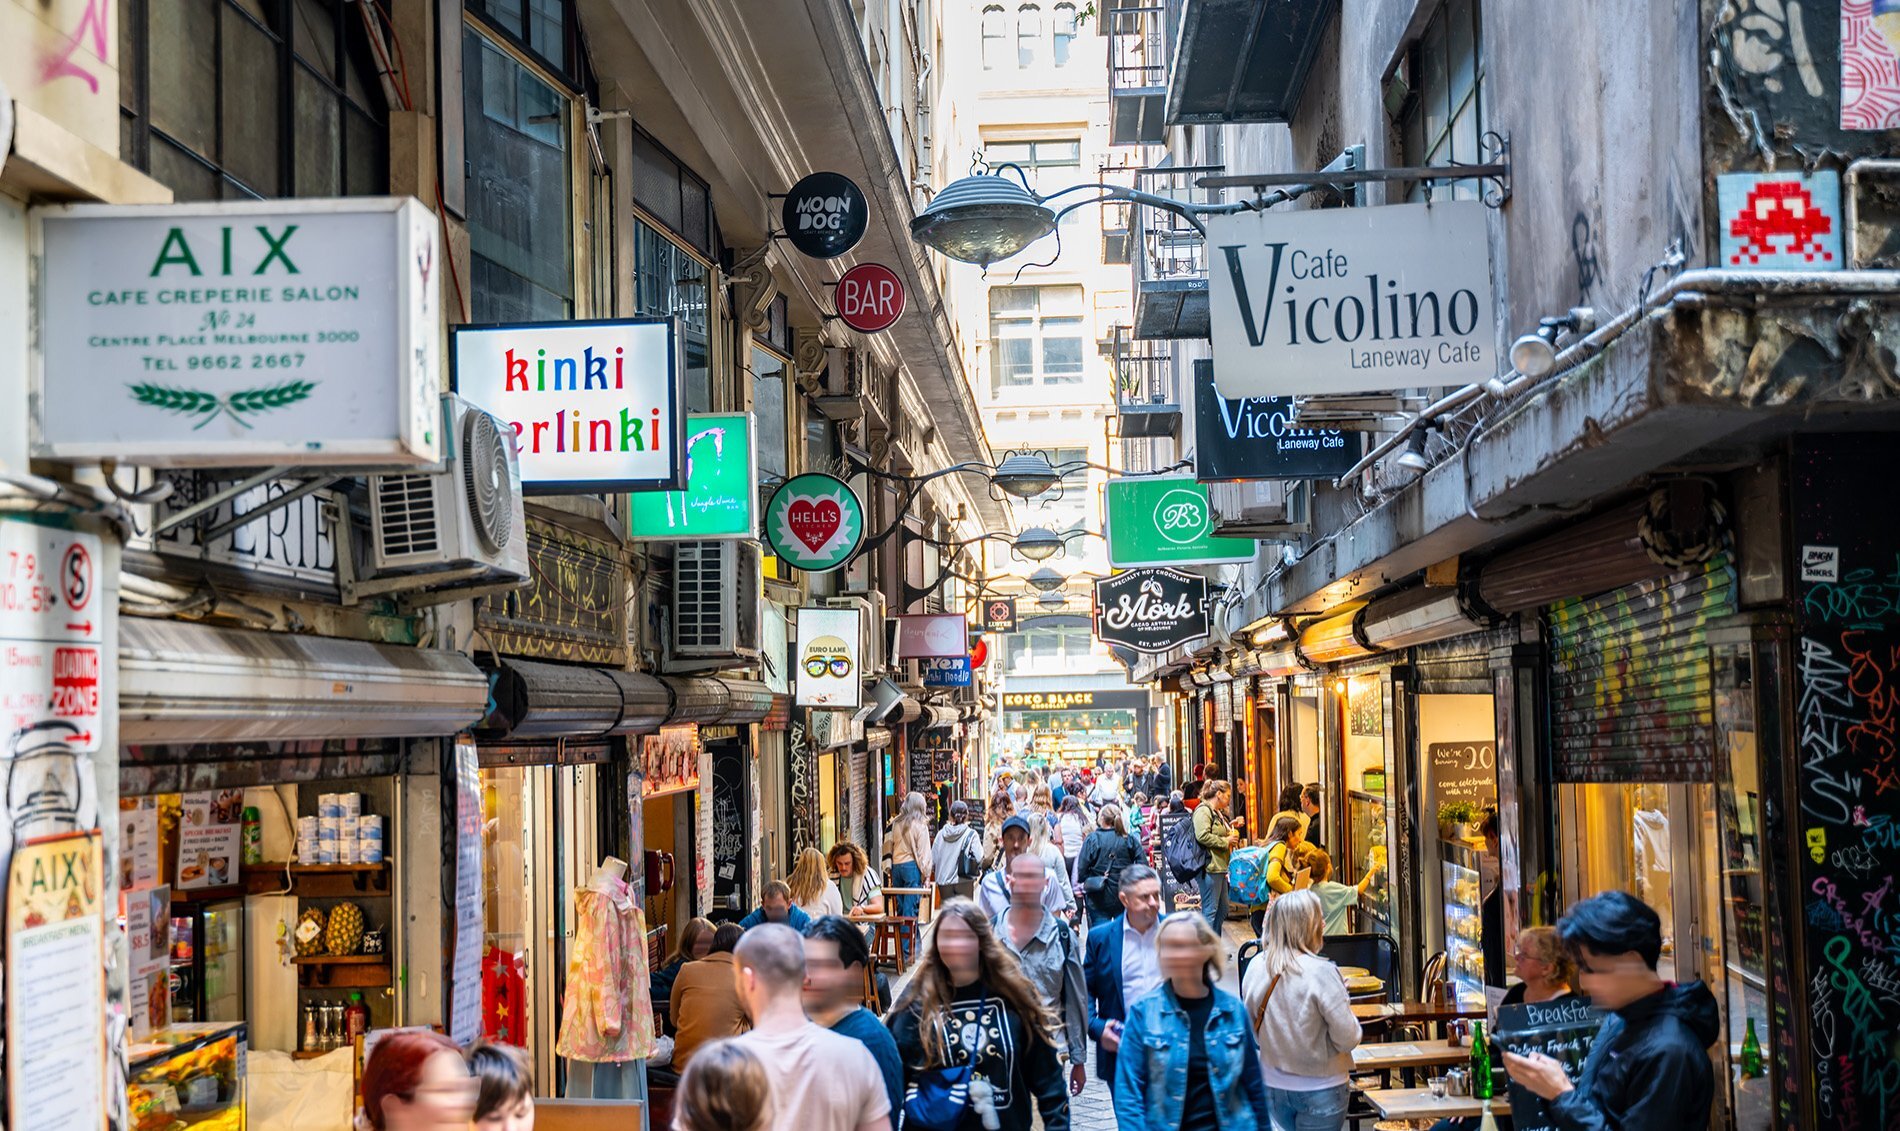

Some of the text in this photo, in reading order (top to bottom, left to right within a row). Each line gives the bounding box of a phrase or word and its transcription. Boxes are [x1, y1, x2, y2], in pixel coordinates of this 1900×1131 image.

[796, 196, 851, 213] MOON
[799, 213, 840, 230] DOG
[149, 224, 301, 277] AIX
[1291, 248, 1348, 280] Cafe
[88, 285, 359, 306] CAFE CREPERIE SALON
[845, 280, 895, 316] BAR
[1218, 242, 1478, 347] Vicolino
[236, 312, 255, 329] 24
[88, 330, 360, 347] CENTRE PLACE MELBOURNE 3000
[142, 354, 306, 370] TEL 9662 2667
[1350, 342, 1481, 370] Laneway Cafe
[505, 346, 624, 391] kinki
[505, 407, 660, 454] erlinki
[1278, 435, 1344, 450] Laneway Cafe
[691, 496, 715, 512] Jungle
[792, 510, 837, 523] HELL'S
[1808, 551, 1833, 560] BNGN
[1111, 571, 1140, 588] SPECIALTY
[1156, 569, 1190, 584] CHOCOLATE
[1107, 593, 1195, 629] Mörk
[52, 687, 98, 713] ZONE
[1004, 693, 1093, 706] KOKO BLACK
[1464, 746, 1494, 770] 20
[1459, 777, 1494, 786] celebrate
[1445, 788, 1461, 796] with
[30, 850, 79, 896] AIX
[1812, 876, 1888, 955] CREEPER
[23, 927, 92, 949] BREAKFAST MENU
[1547, 1039, 1580, 1053] French
